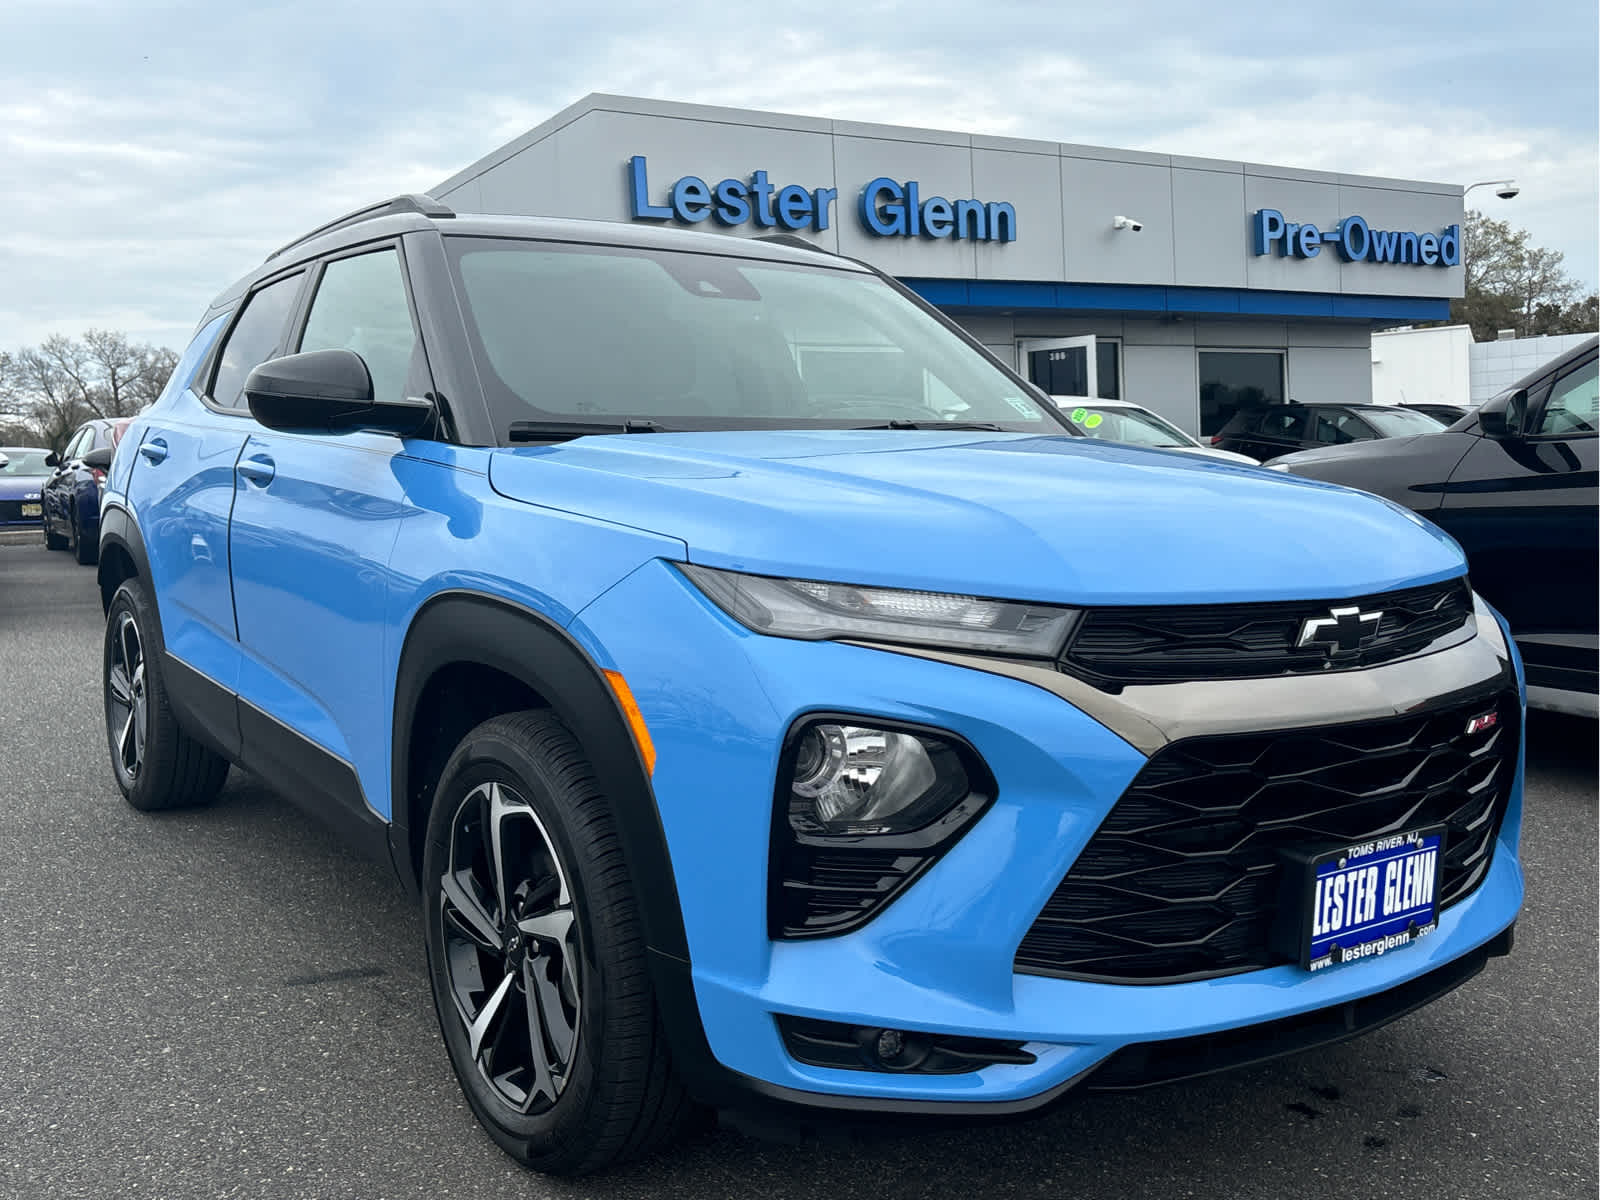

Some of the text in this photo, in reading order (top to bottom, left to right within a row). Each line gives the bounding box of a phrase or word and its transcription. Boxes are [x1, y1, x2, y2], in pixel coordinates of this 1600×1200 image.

[628, 155, 1017, 242] Lester Glenn
[1255, 208, 1460, 266] Pre-Owned
[1347, 831, 1419, 860] TOMS RIVER, NJ
[1312, 850, 1437, 937] LESTER GLENN
